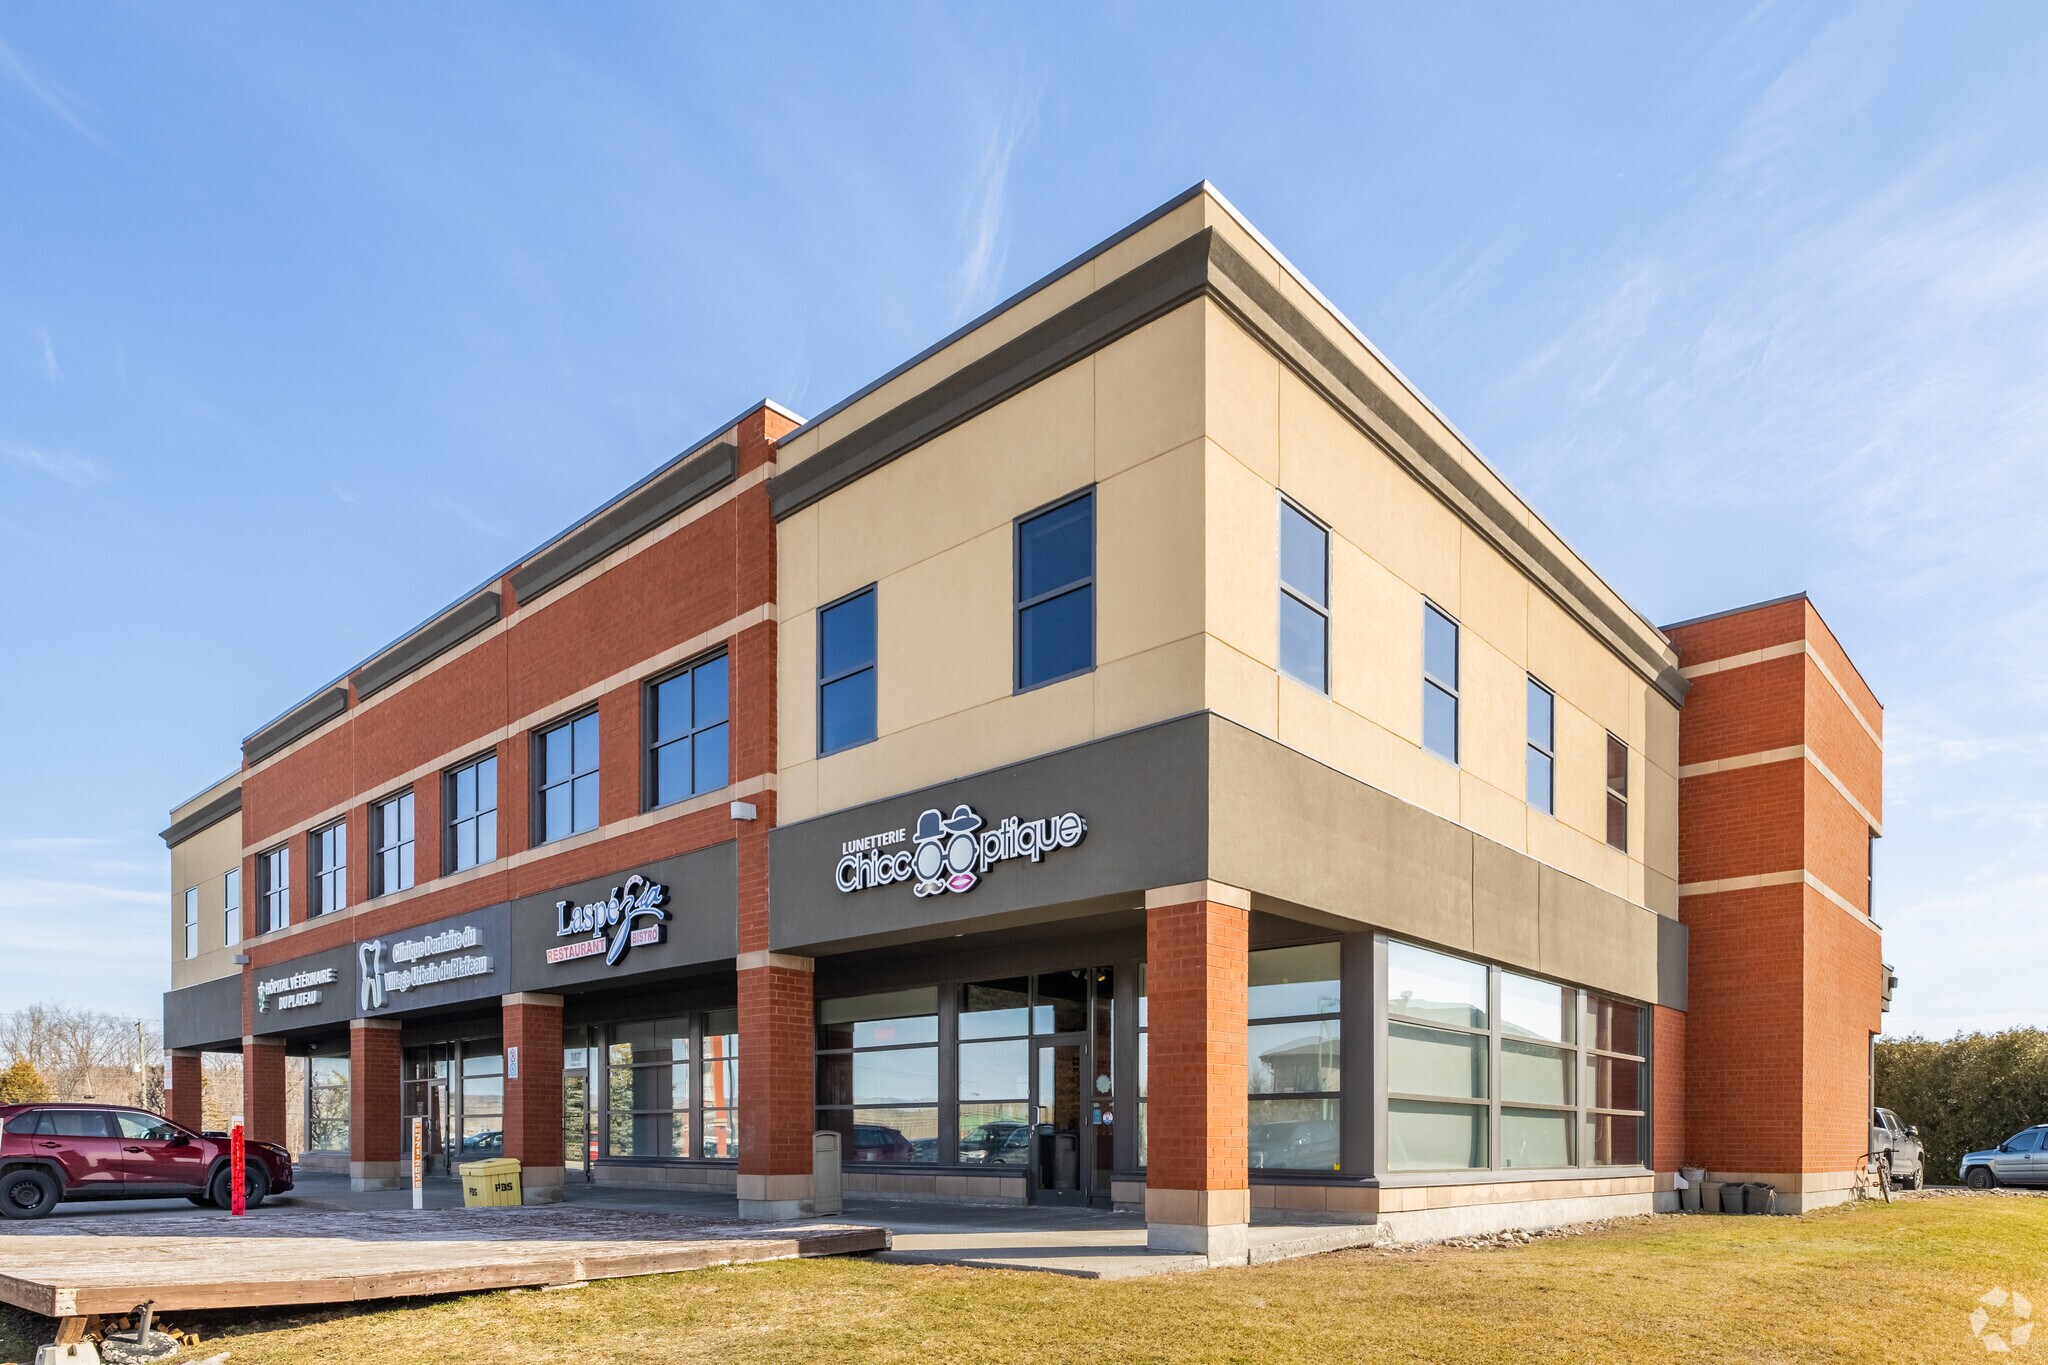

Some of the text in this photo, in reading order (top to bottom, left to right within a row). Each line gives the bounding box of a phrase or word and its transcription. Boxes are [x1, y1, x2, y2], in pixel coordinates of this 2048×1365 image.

[842, 828, 906, 855] LUNETTERIE
[392, 926, 477, 963] Clinique Dentaire du
[547, 929, 658, 962] RESTAURANT BISTRO
[265, 968, 333, 995] HÔPITAL VÉTÉRINAIRE
[384, 955, 488, 993] Village Urbain du Plateau
[278, 990, 318, 1010] DU PLATEAU
[494, 1182, 513, 1193] PBS
